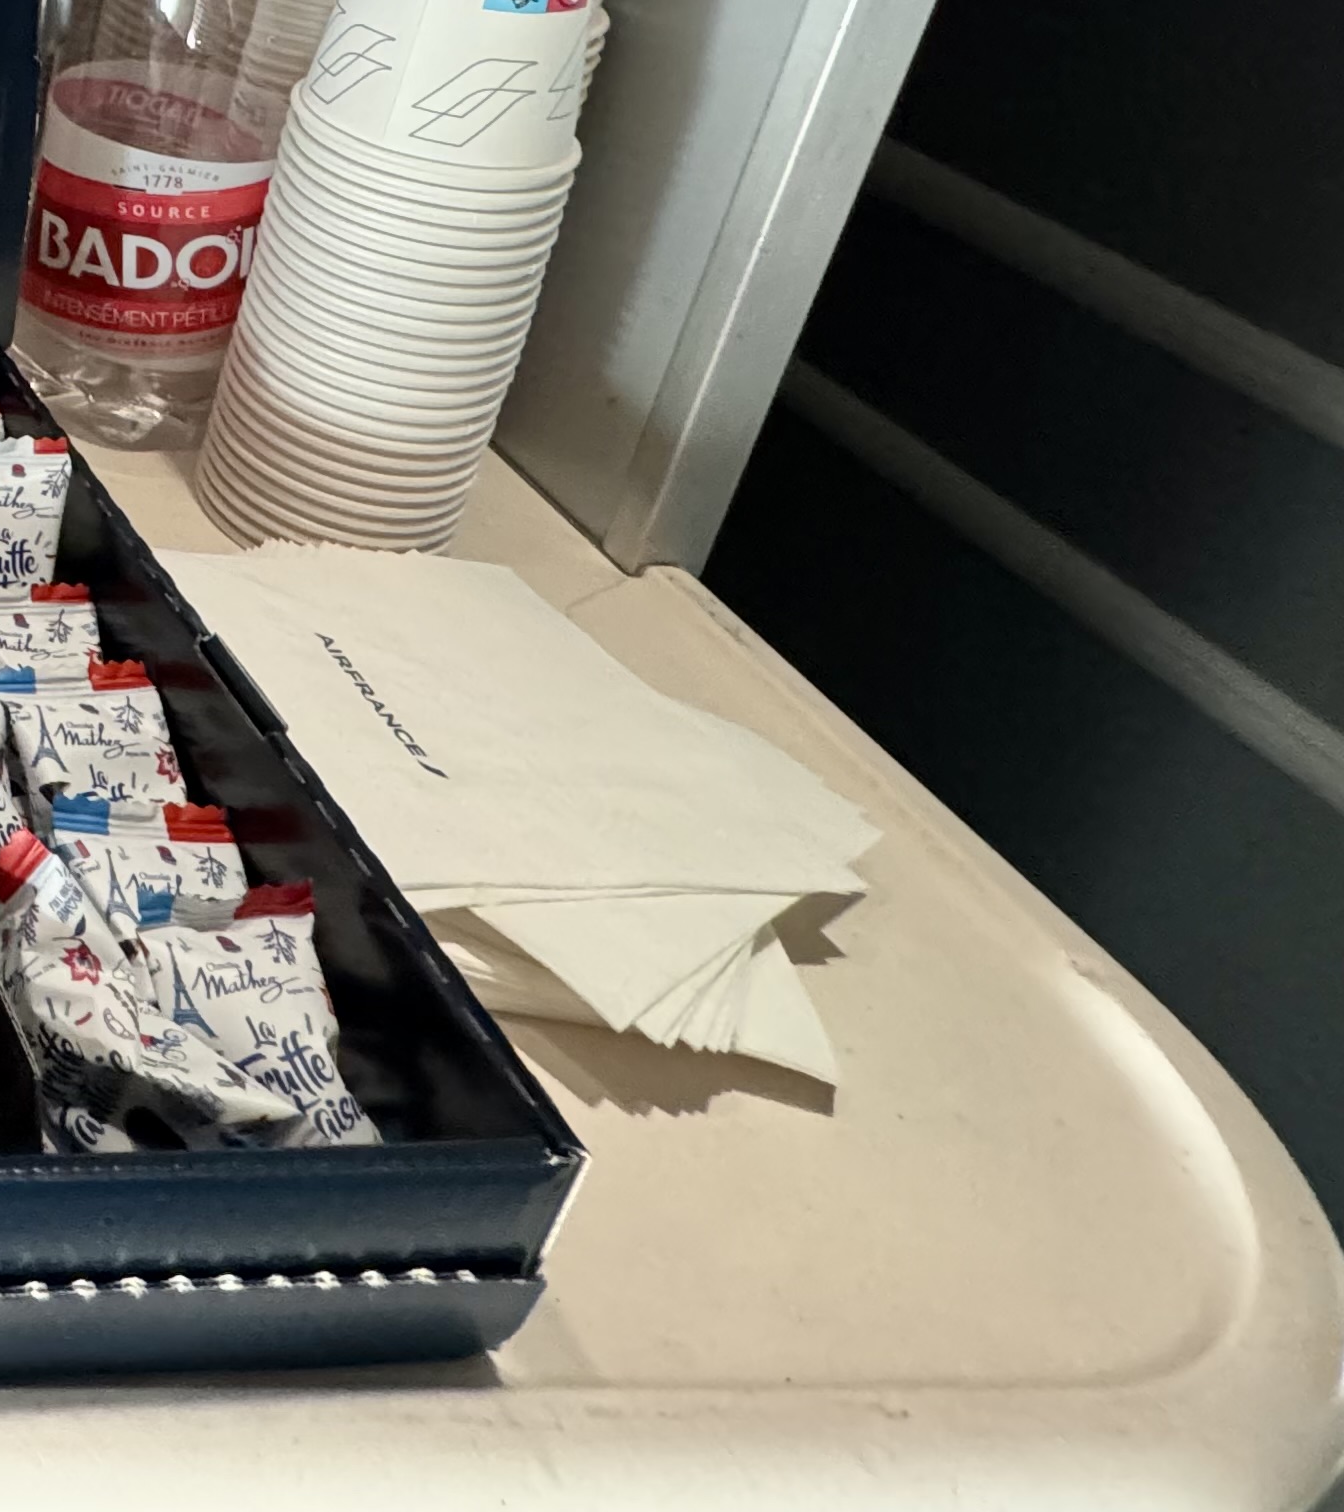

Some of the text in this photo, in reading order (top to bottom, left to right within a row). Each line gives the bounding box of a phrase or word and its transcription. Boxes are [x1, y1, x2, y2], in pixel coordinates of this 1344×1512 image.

[142, 174, 184, 188] 1778
[117, 201, 212, 219] SOURCE
[38, 207, 259, 290] BADOI
[314, 631, 429, 759] AIRFRANCE
[54, 722, 127, 759] Mathez
[88, 763, 109, 788] La
[192, 959, 287, 1004] Mathez
[244, 1015, 278, 1049] La
